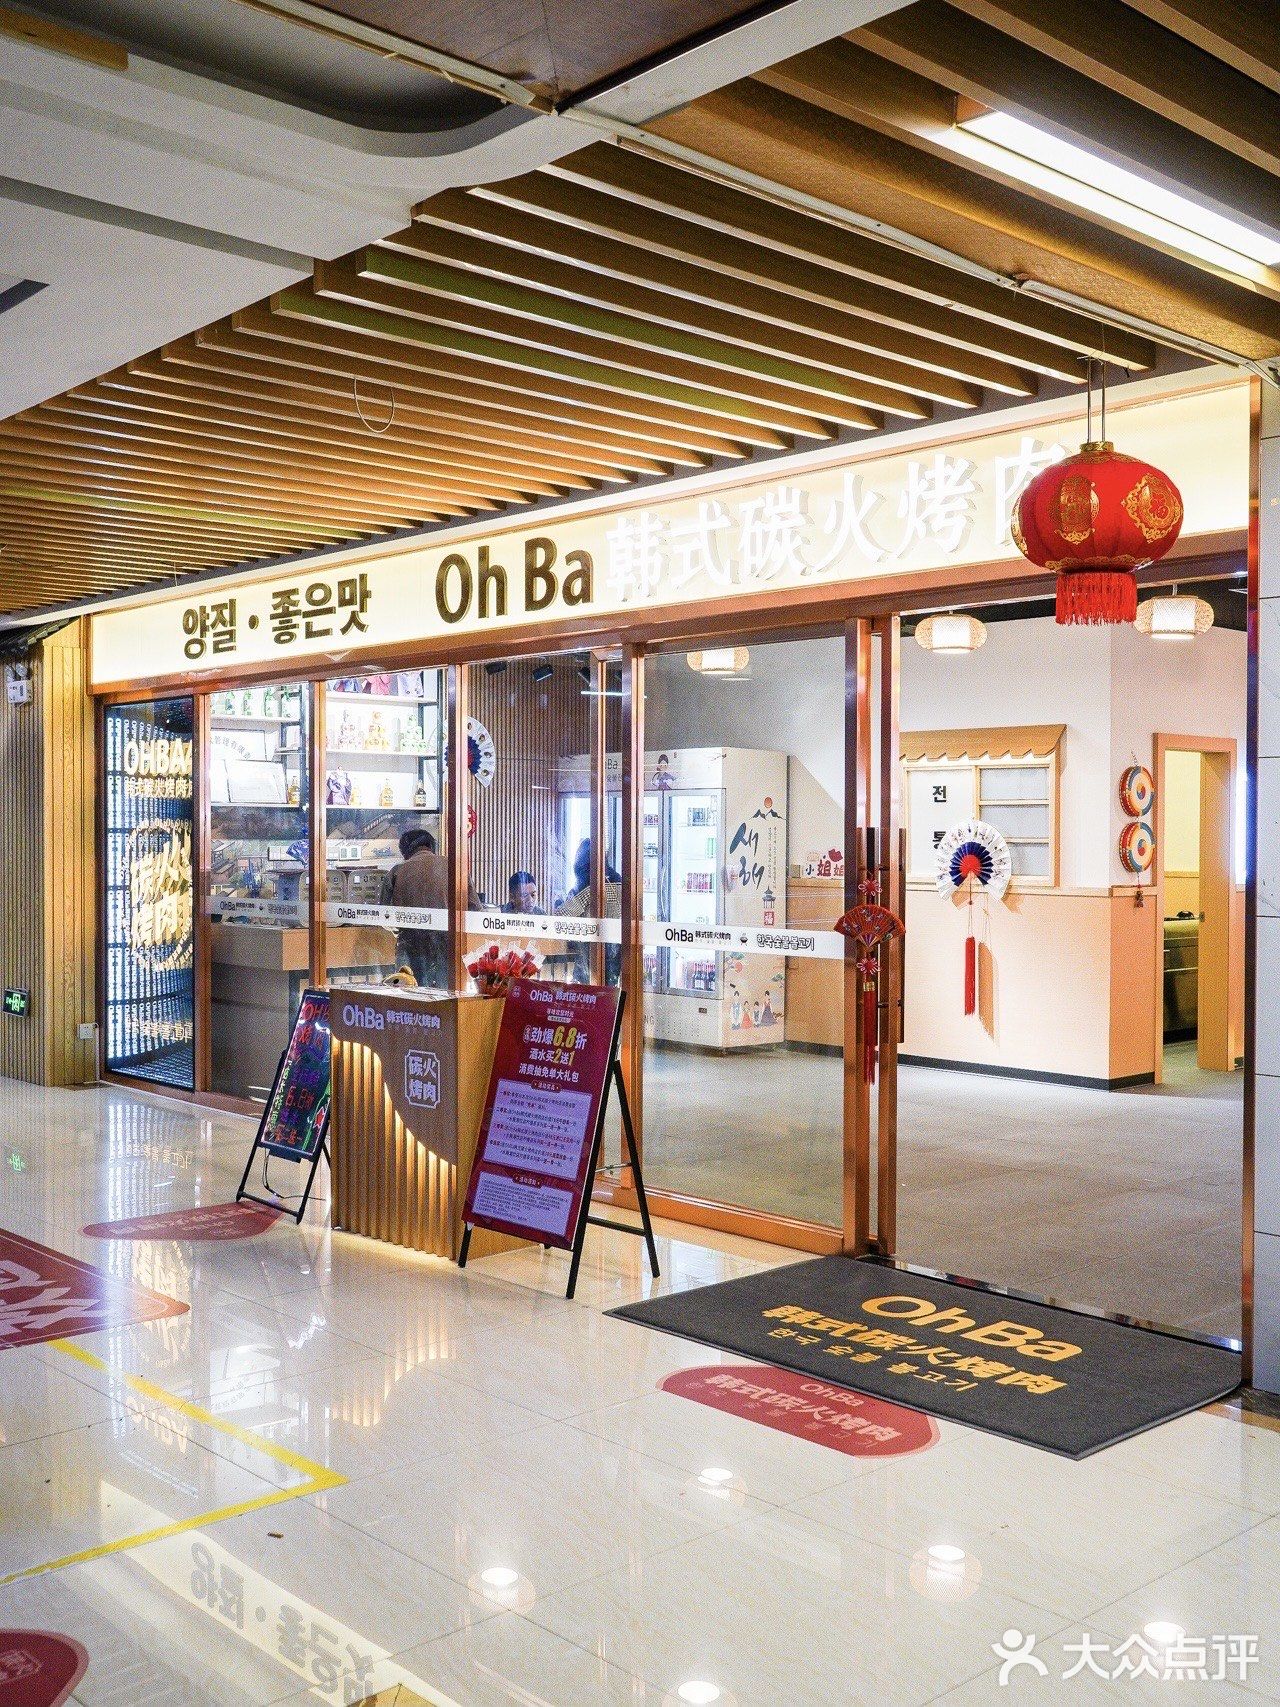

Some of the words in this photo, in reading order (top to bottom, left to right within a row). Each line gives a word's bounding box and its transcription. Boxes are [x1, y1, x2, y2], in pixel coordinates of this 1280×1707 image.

[483, 917, 506, 931] OhBa
[665, 928, 694, 943] OhBa
[530, 989, 554, 1003] OhBa
[342, 1004, 385, 1030] OhBa
[862, 1295, 1082, 1362] OhBa
[799, 1382, 865, 1407] OhBa
